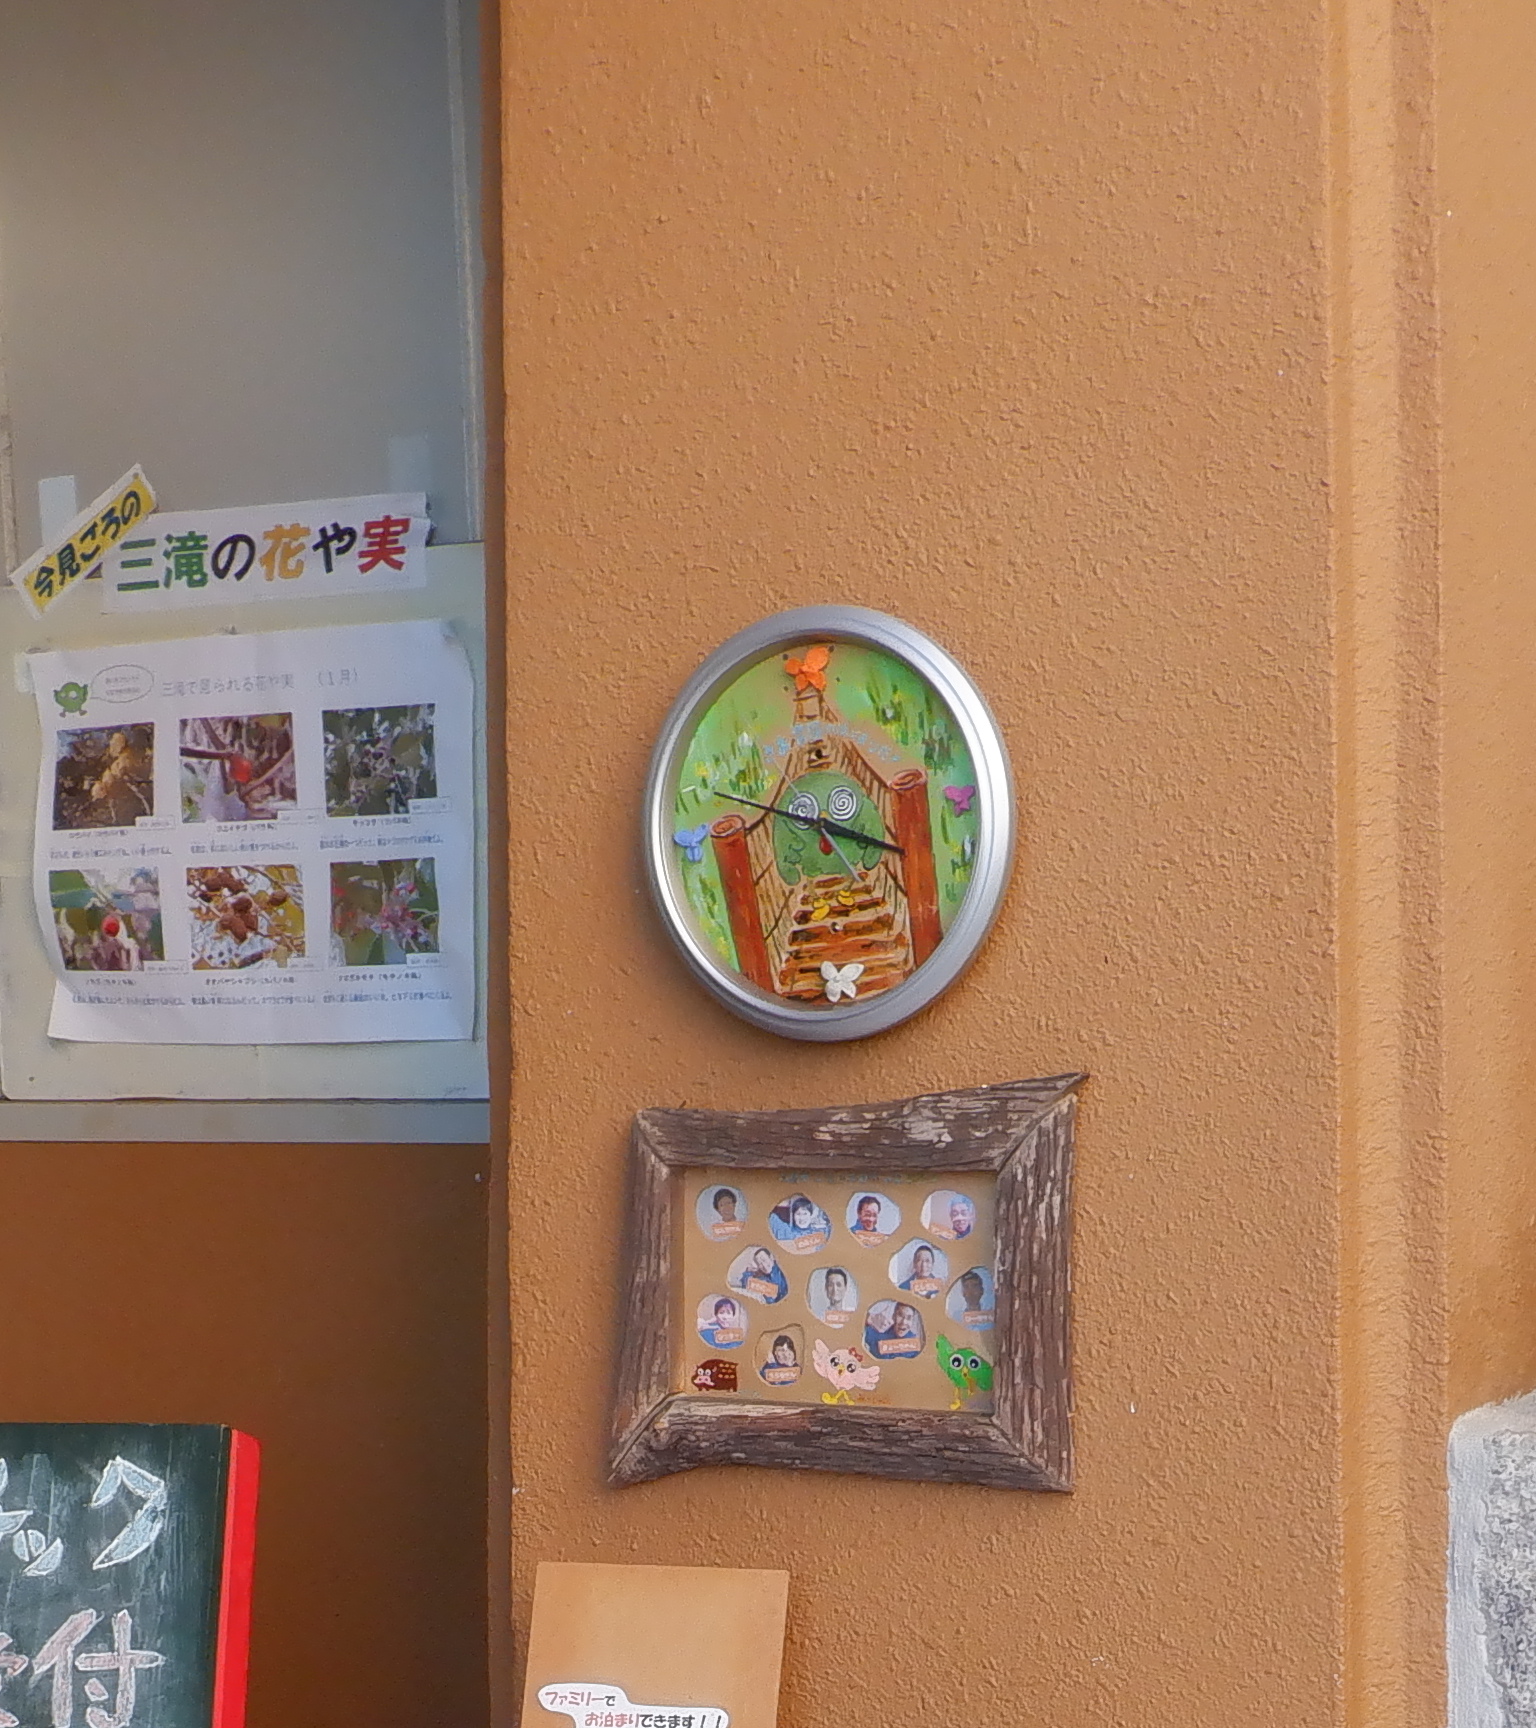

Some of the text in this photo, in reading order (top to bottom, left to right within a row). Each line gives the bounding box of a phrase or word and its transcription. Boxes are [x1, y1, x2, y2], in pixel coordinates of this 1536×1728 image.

[32, 489, 143, 599] 今見ごろの
[116, 515, 412, 593] 三滝の花や実
[545, 1691, 616, 1707] ファミリーで
